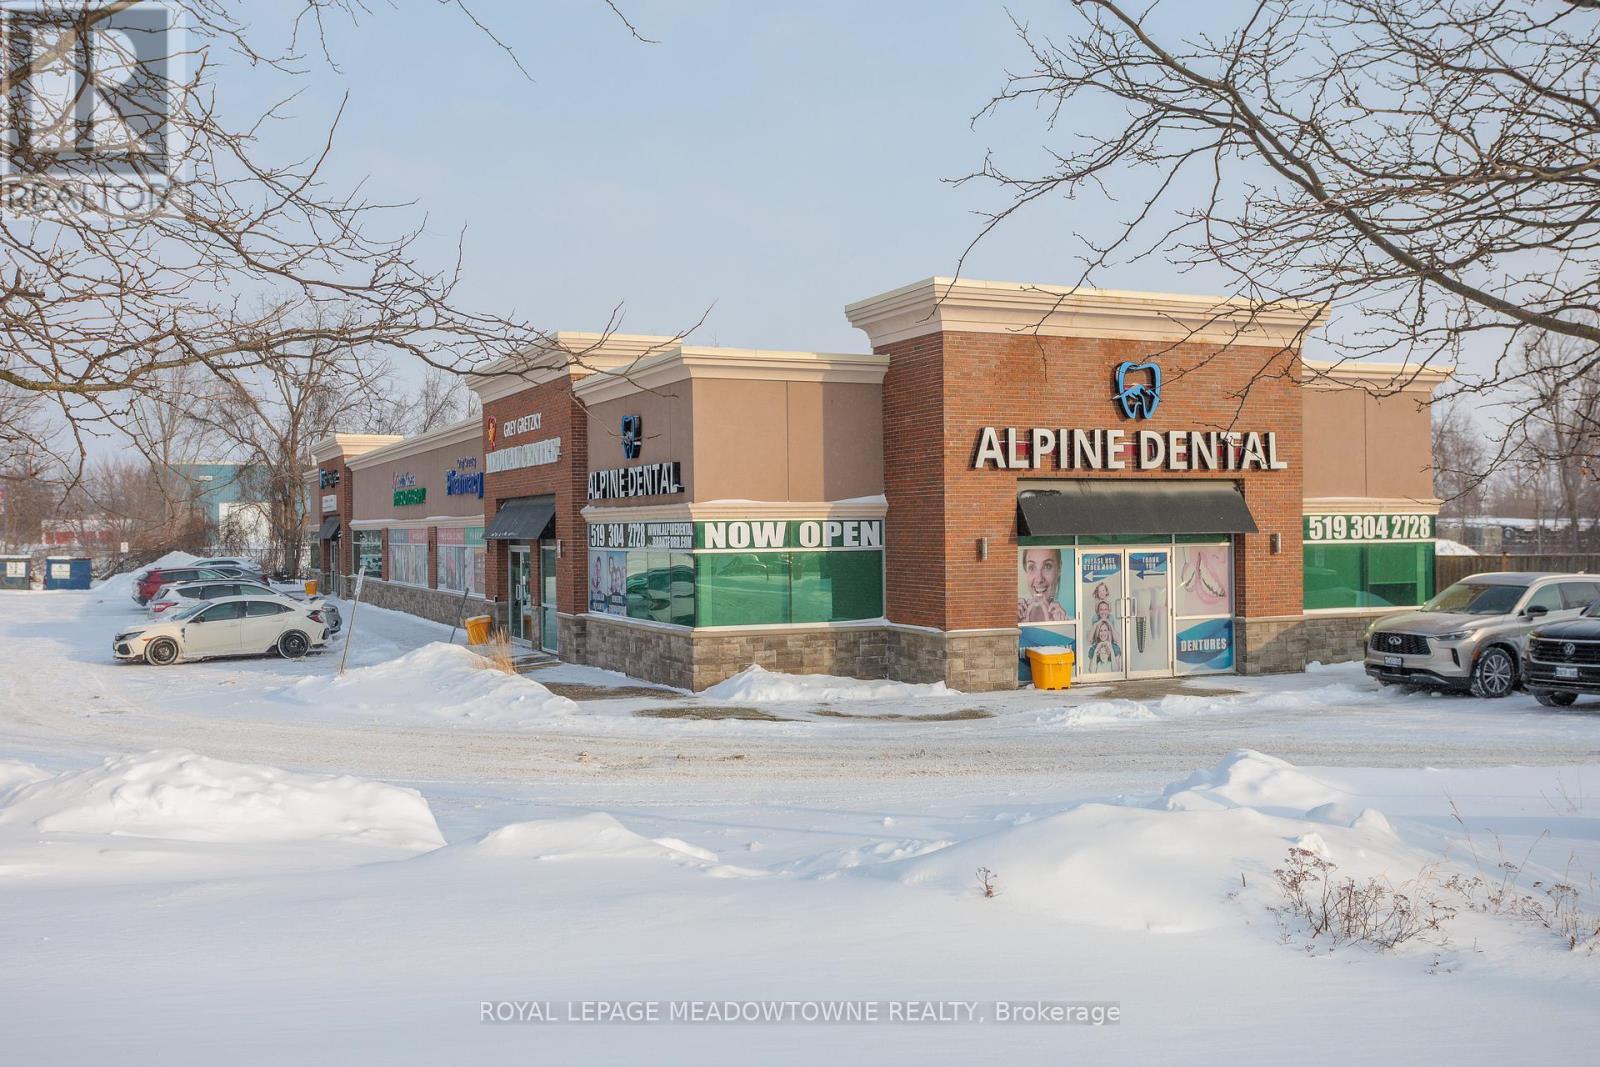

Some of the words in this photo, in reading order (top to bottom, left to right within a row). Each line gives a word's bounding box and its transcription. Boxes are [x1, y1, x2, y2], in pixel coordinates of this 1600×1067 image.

[504, 420, 517, 437] GREY
[517, 412, 542, 434] GRETZKY
[975, 427, 1125, 470] ALPINE
[1141, 430, 1288, 470] DENTAL
[588, 468, 626, 499] ALPINE
[628, 462, 678, 496] DENTAL
[591, 524, 605, 547] 519
[608, 524, 624, 547] 304
[627, 523, 646, 547] 2728
[704, 521, 787, 549] NOW
[799, 520, 880, 548] OPEN
[1309, 516, 1347, 540] 519
[1350, 516, 1388, 539] 304
[1391, 515, 1430, 538] 2728
[1180, 637, 1227, 652] DENTURES
